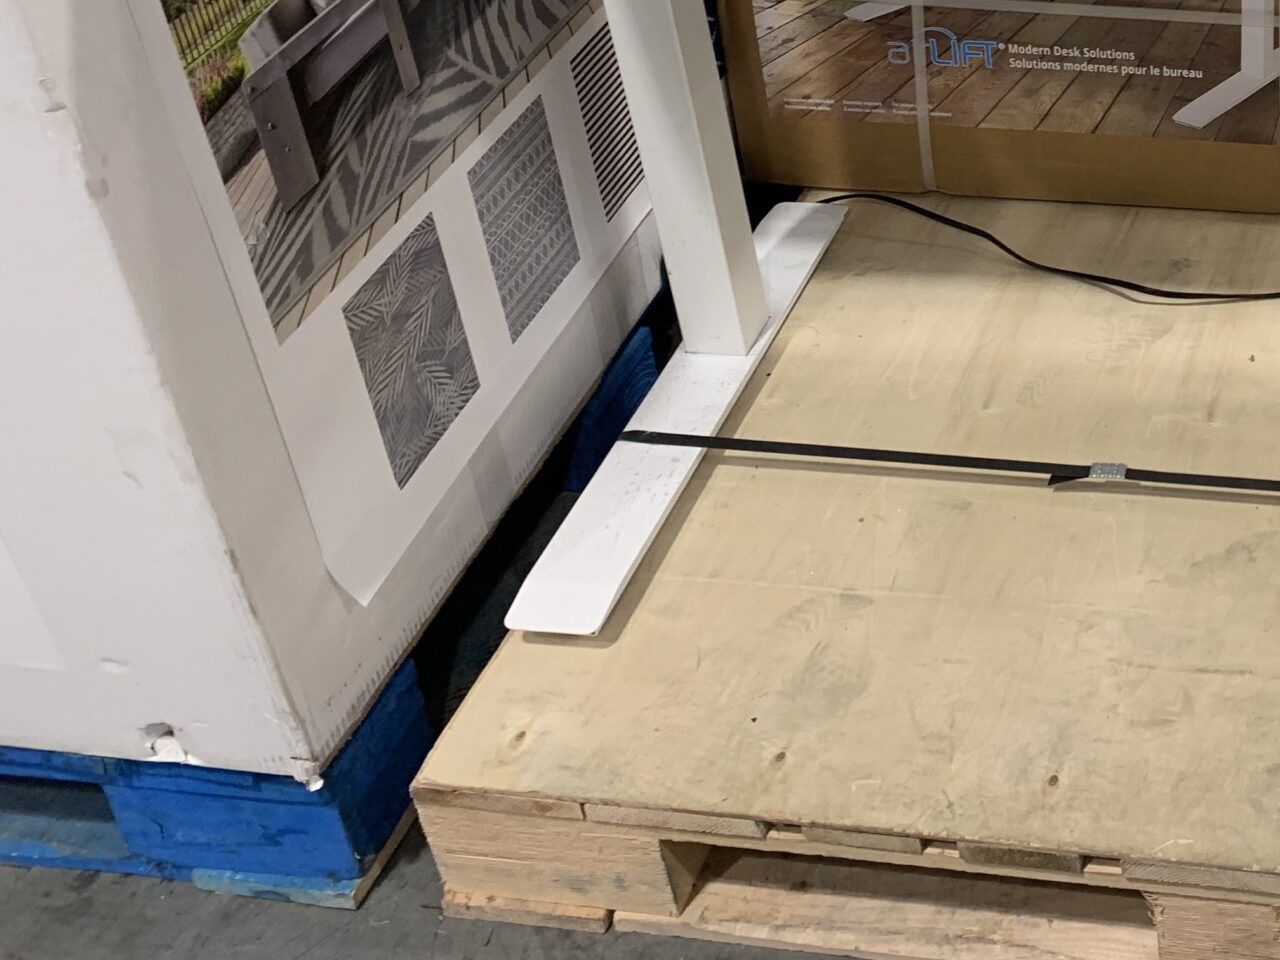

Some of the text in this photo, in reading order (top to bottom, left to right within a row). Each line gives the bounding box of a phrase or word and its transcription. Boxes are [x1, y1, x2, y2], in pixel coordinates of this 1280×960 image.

[1009, 43, 1135, 61] Modern Desk Solutions
[1009, 57, 1203, 78] Solutions modernes pour le bureau
